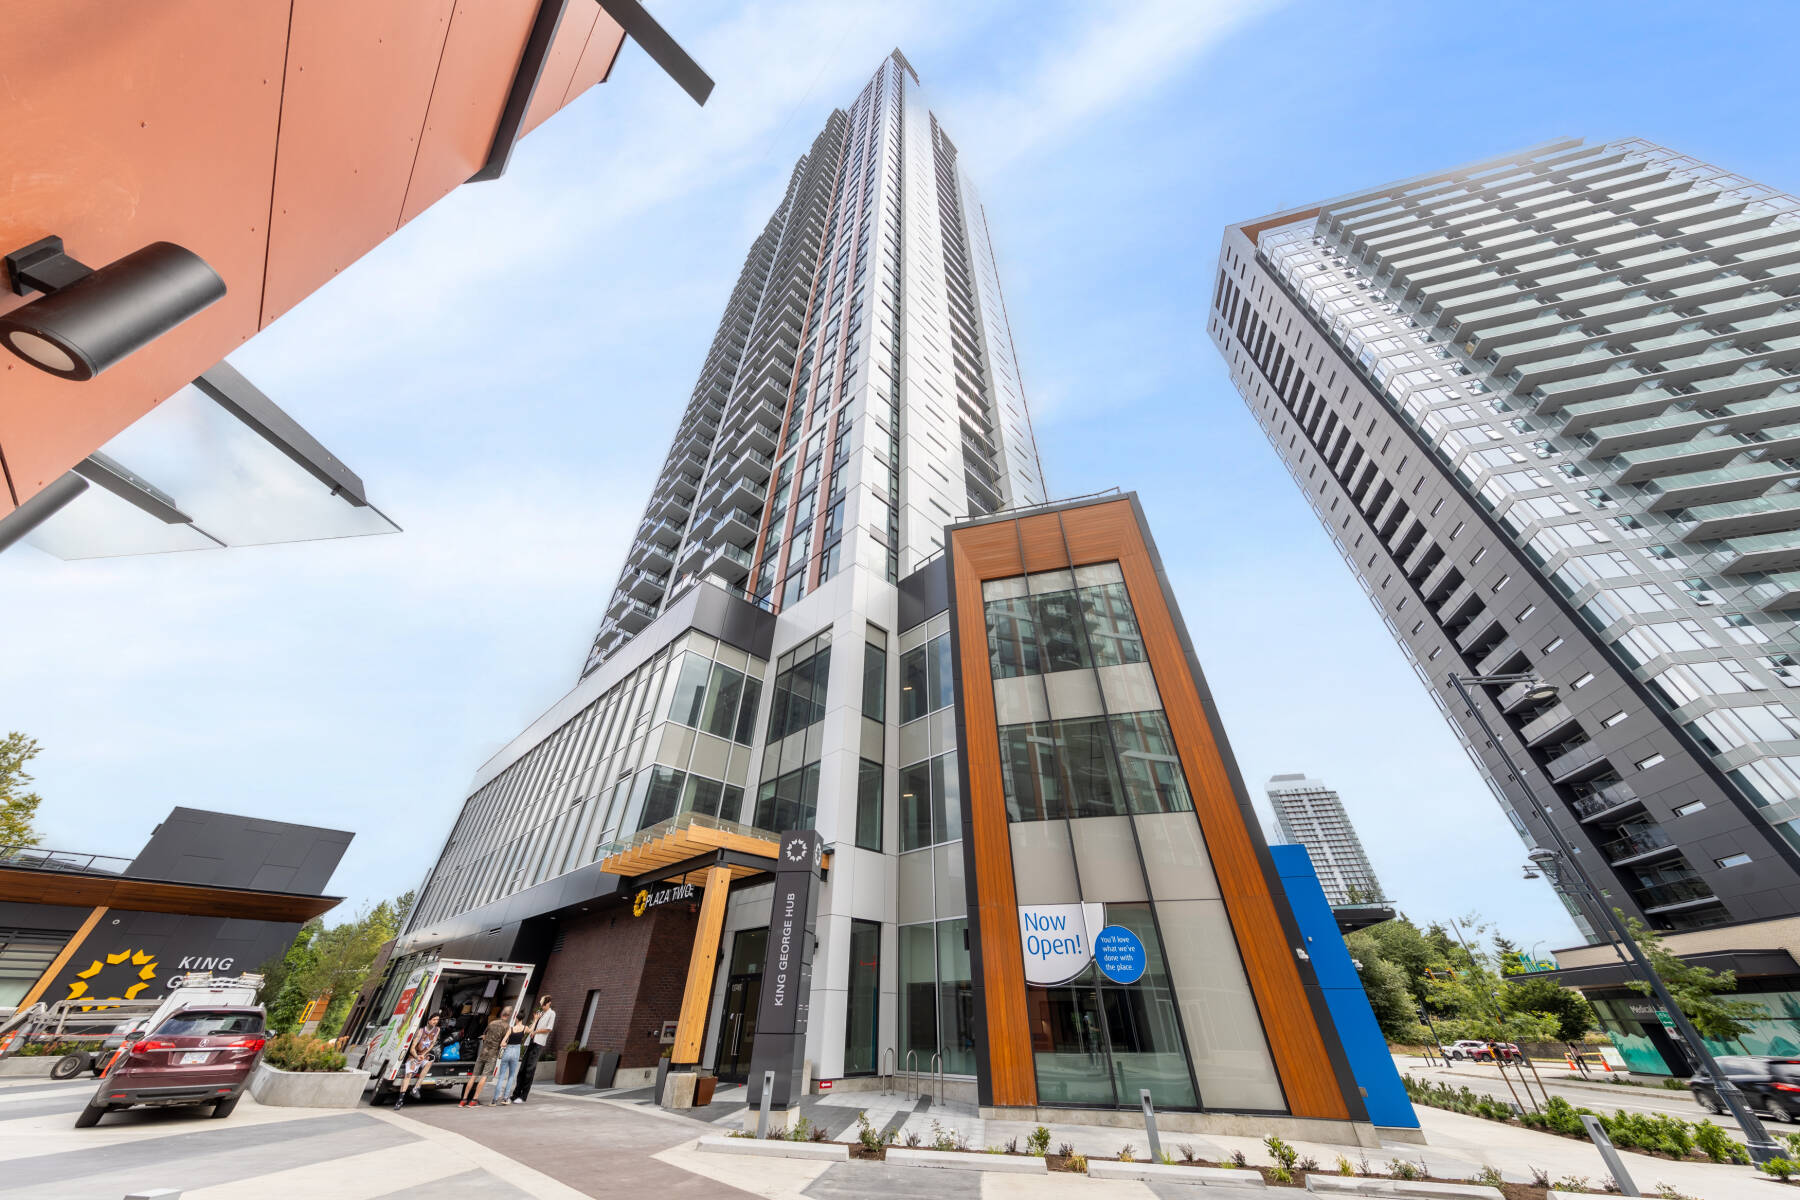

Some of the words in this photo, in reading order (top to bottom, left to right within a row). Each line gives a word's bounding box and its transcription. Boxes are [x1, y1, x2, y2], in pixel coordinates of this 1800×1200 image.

[645, 889, 671, 908] PLAZA
[672, 884, 694, 901] TWO
[785, 893, 795, 917] HUB
[1024, 912, 1066, 932] Now
[779, 920, 792, 970] GEORGE
[1027, 934, 1082, 960] Open!
[1117, 936, 1130, 944] love
[178, 956, 235, 971] KING
[1104, 954, 1118, 962] done
[1105, 963, 1116, 971] the
[774, 974, 786, 1006] KING
